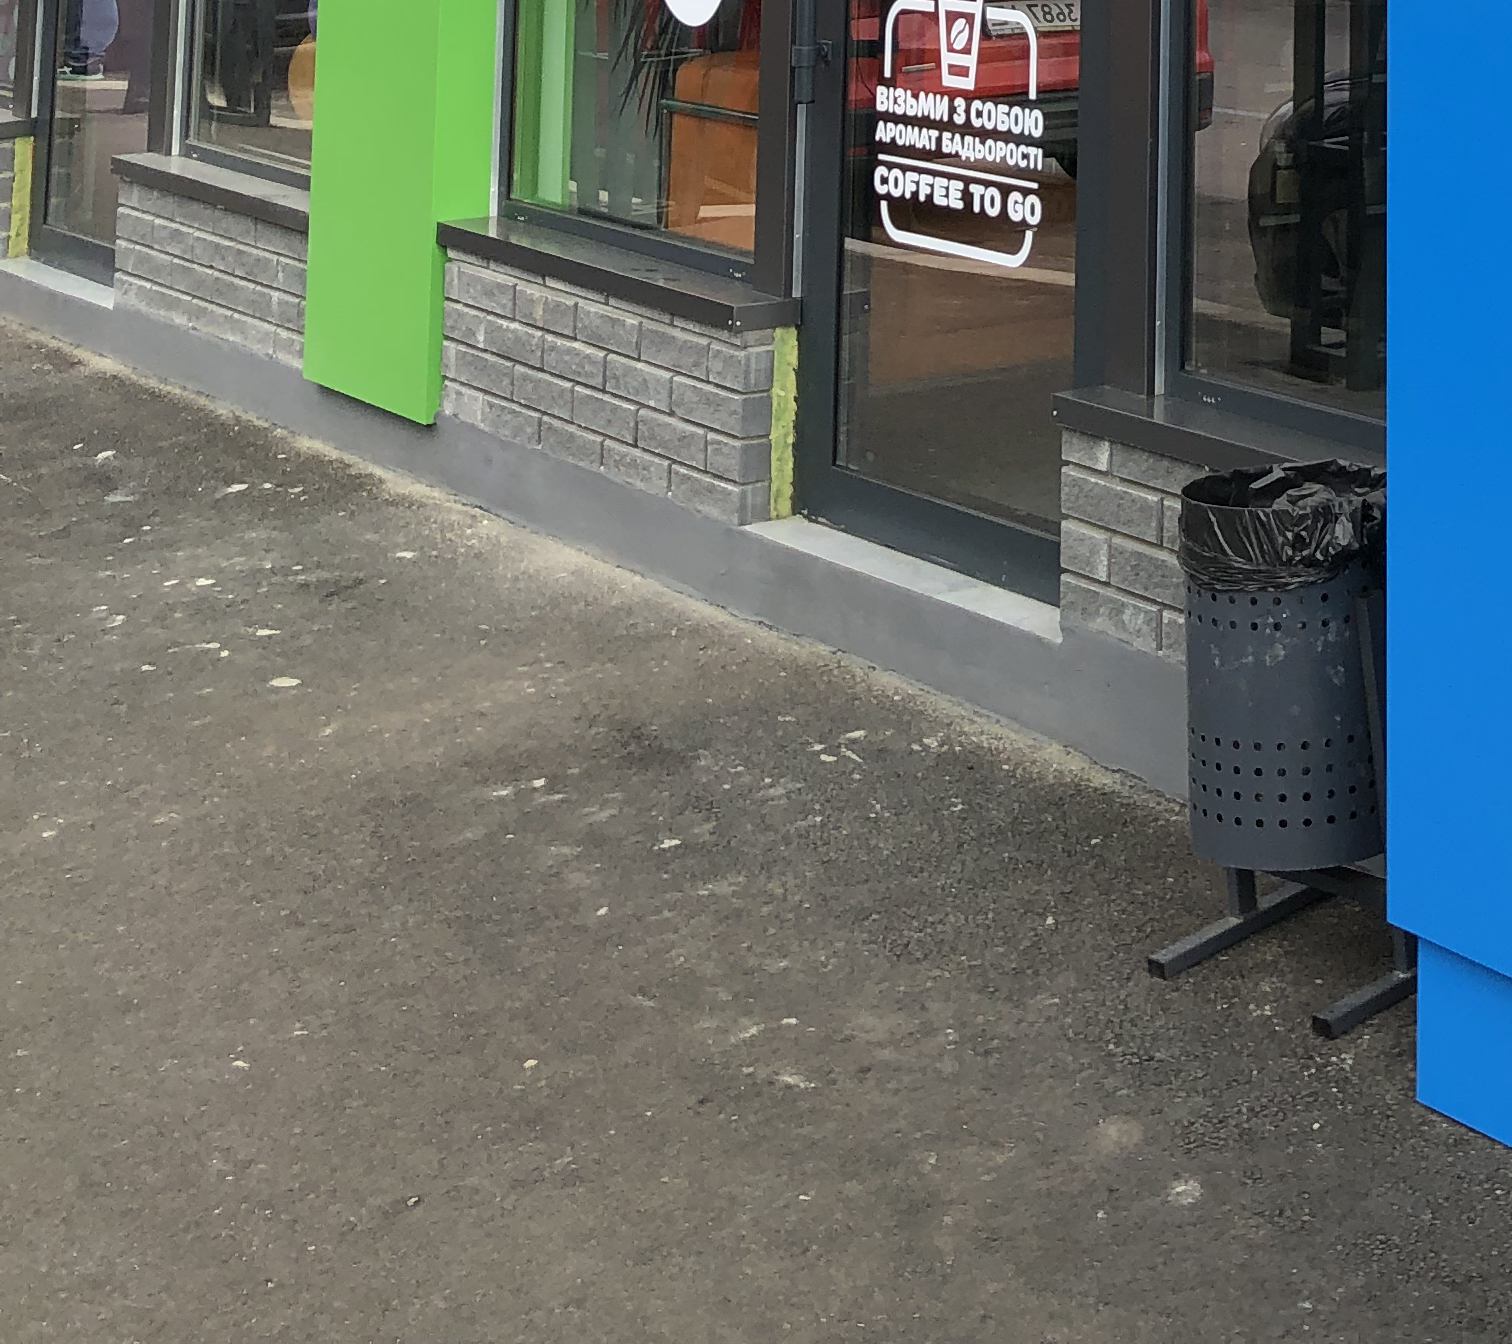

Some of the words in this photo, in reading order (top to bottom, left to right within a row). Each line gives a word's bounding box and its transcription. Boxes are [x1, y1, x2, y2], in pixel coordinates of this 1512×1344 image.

[876, 85, 949, 122] ВІЗЬМИ
[970, 99, 1044, 138] СОБОЮ
[875, 120, 937, 153] АРОМАТ
[942, 131, 1043, 171] БАДЬОРОСТІ
[874, 166, 964, 211] COFFEE
[968, 183, 1001, 218] TO
[1007, 191, 1041, 226] GO
